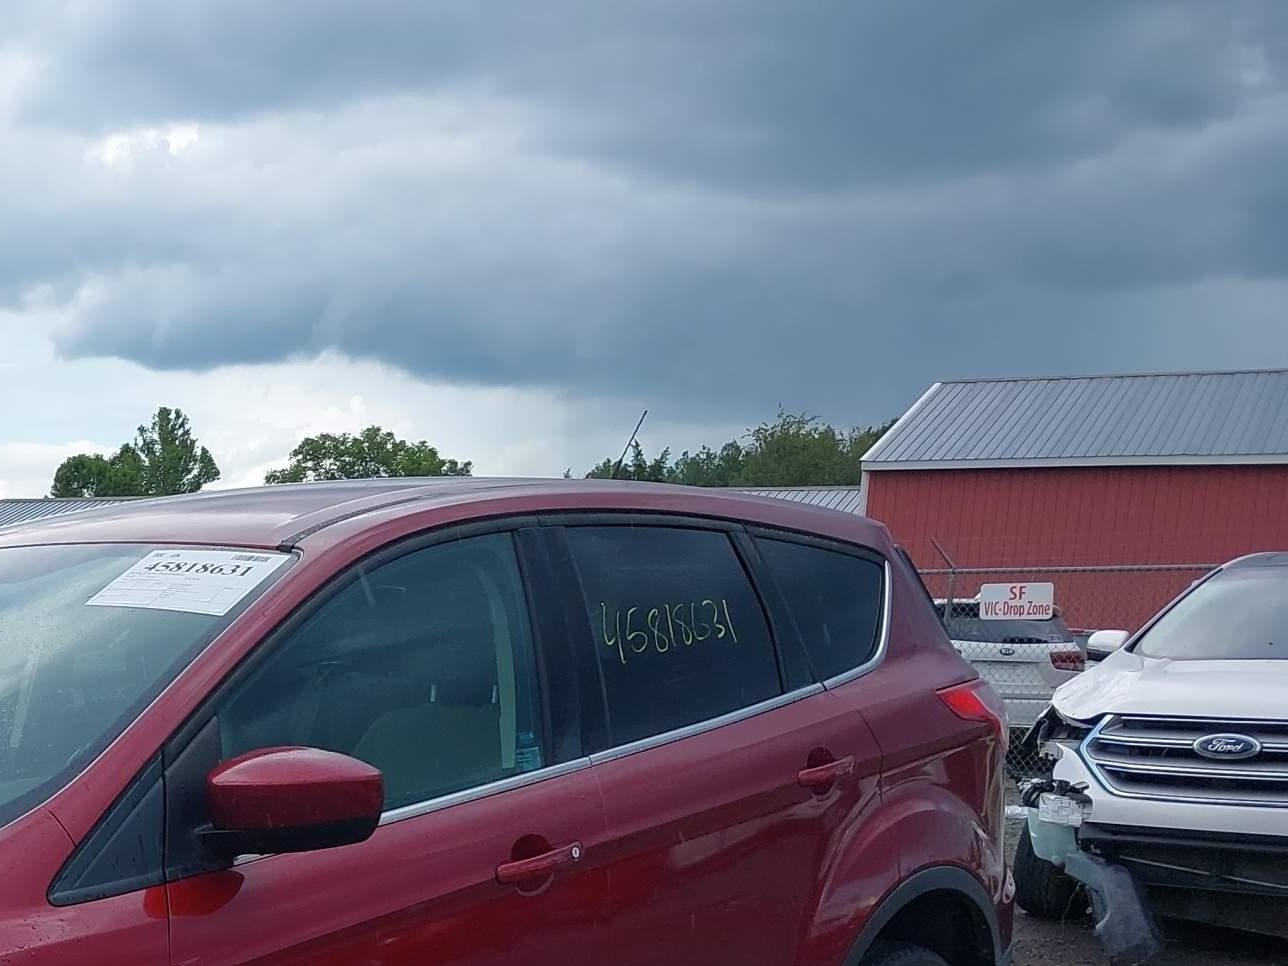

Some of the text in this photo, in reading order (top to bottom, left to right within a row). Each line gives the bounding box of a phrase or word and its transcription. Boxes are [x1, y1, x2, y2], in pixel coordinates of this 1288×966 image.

[144, 561, 253, 577] 45818631
[1009, 586, 1026, 600] SF
[984, 601, 1050, 617] VIC-Drop Zone
[601, 600, 737, 664] 45818631
[1207, 738, 1245, 752] Ford
